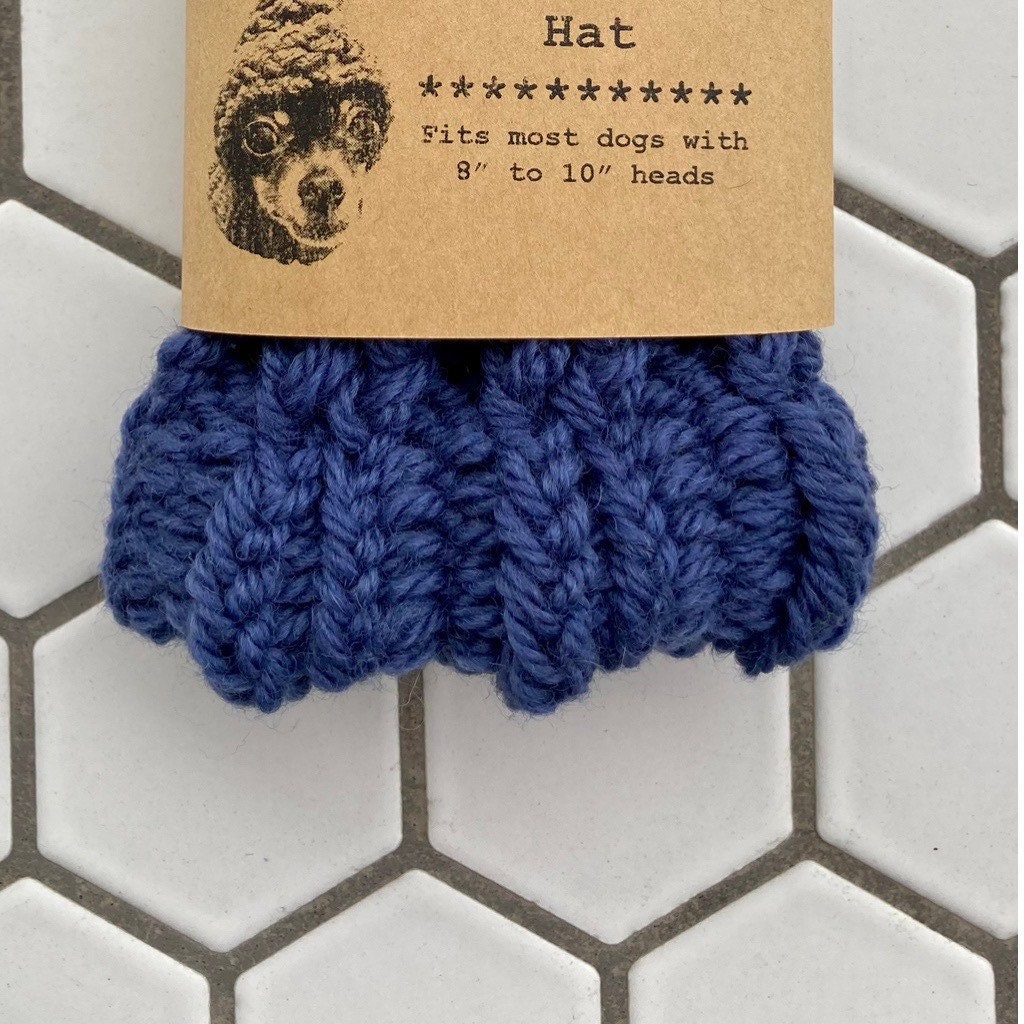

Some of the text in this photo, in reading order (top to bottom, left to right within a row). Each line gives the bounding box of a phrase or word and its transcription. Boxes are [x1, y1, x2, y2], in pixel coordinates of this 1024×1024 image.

[543, 15, 637, 50] Hat
[421, 124, 749, 154] Fits most dogs with
[509, 162, 543, 182] to
[630, 163, 715, 186] heads
